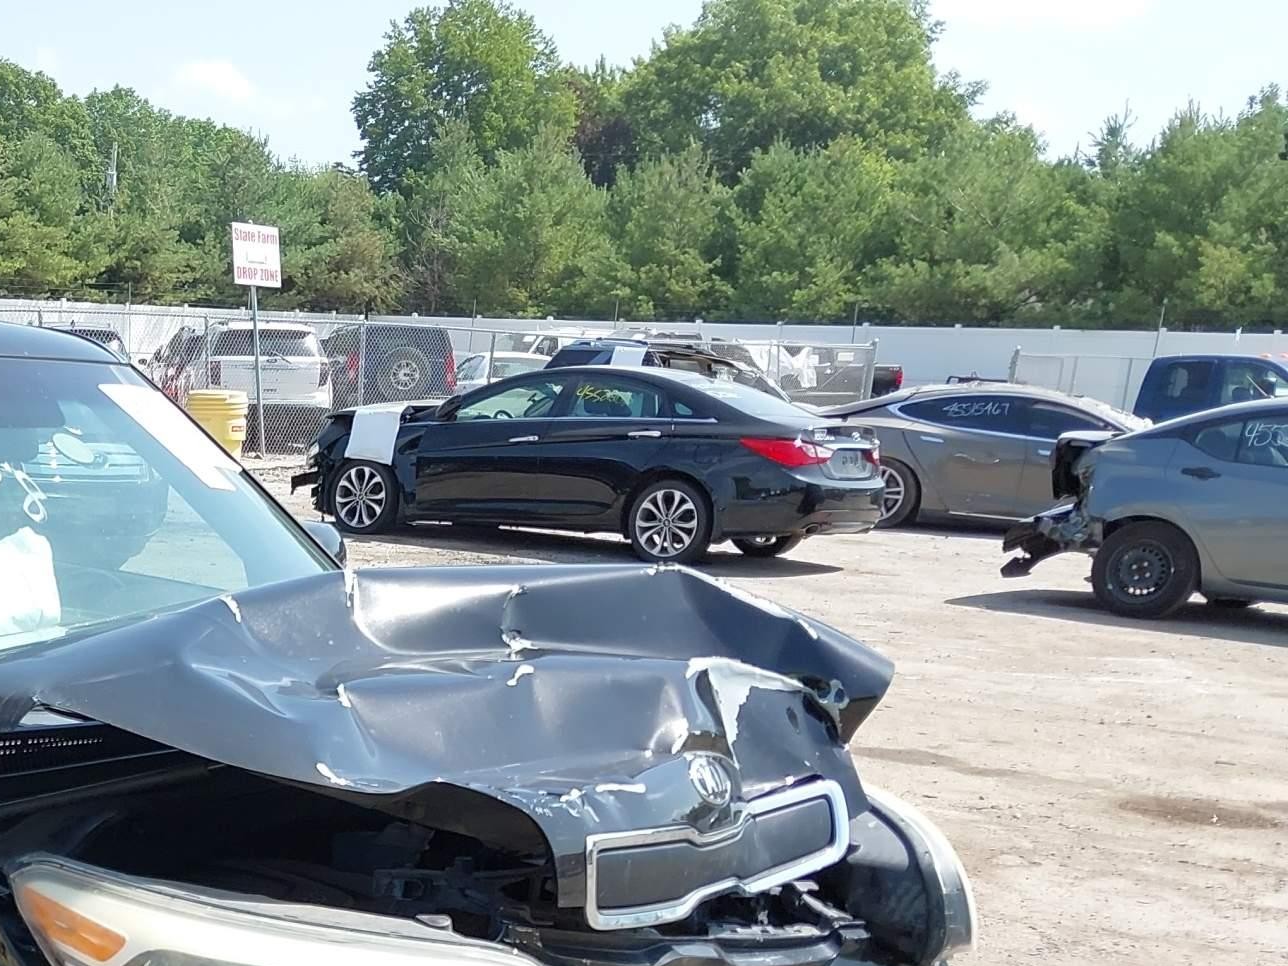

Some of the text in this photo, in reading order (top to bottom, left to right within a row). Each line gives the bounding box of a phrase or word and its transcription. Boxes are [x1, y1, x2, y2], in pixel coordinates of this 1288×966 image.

[234, 227, 278, 246] State Farm
[236, 266, 279, 283] DROP ZONE
